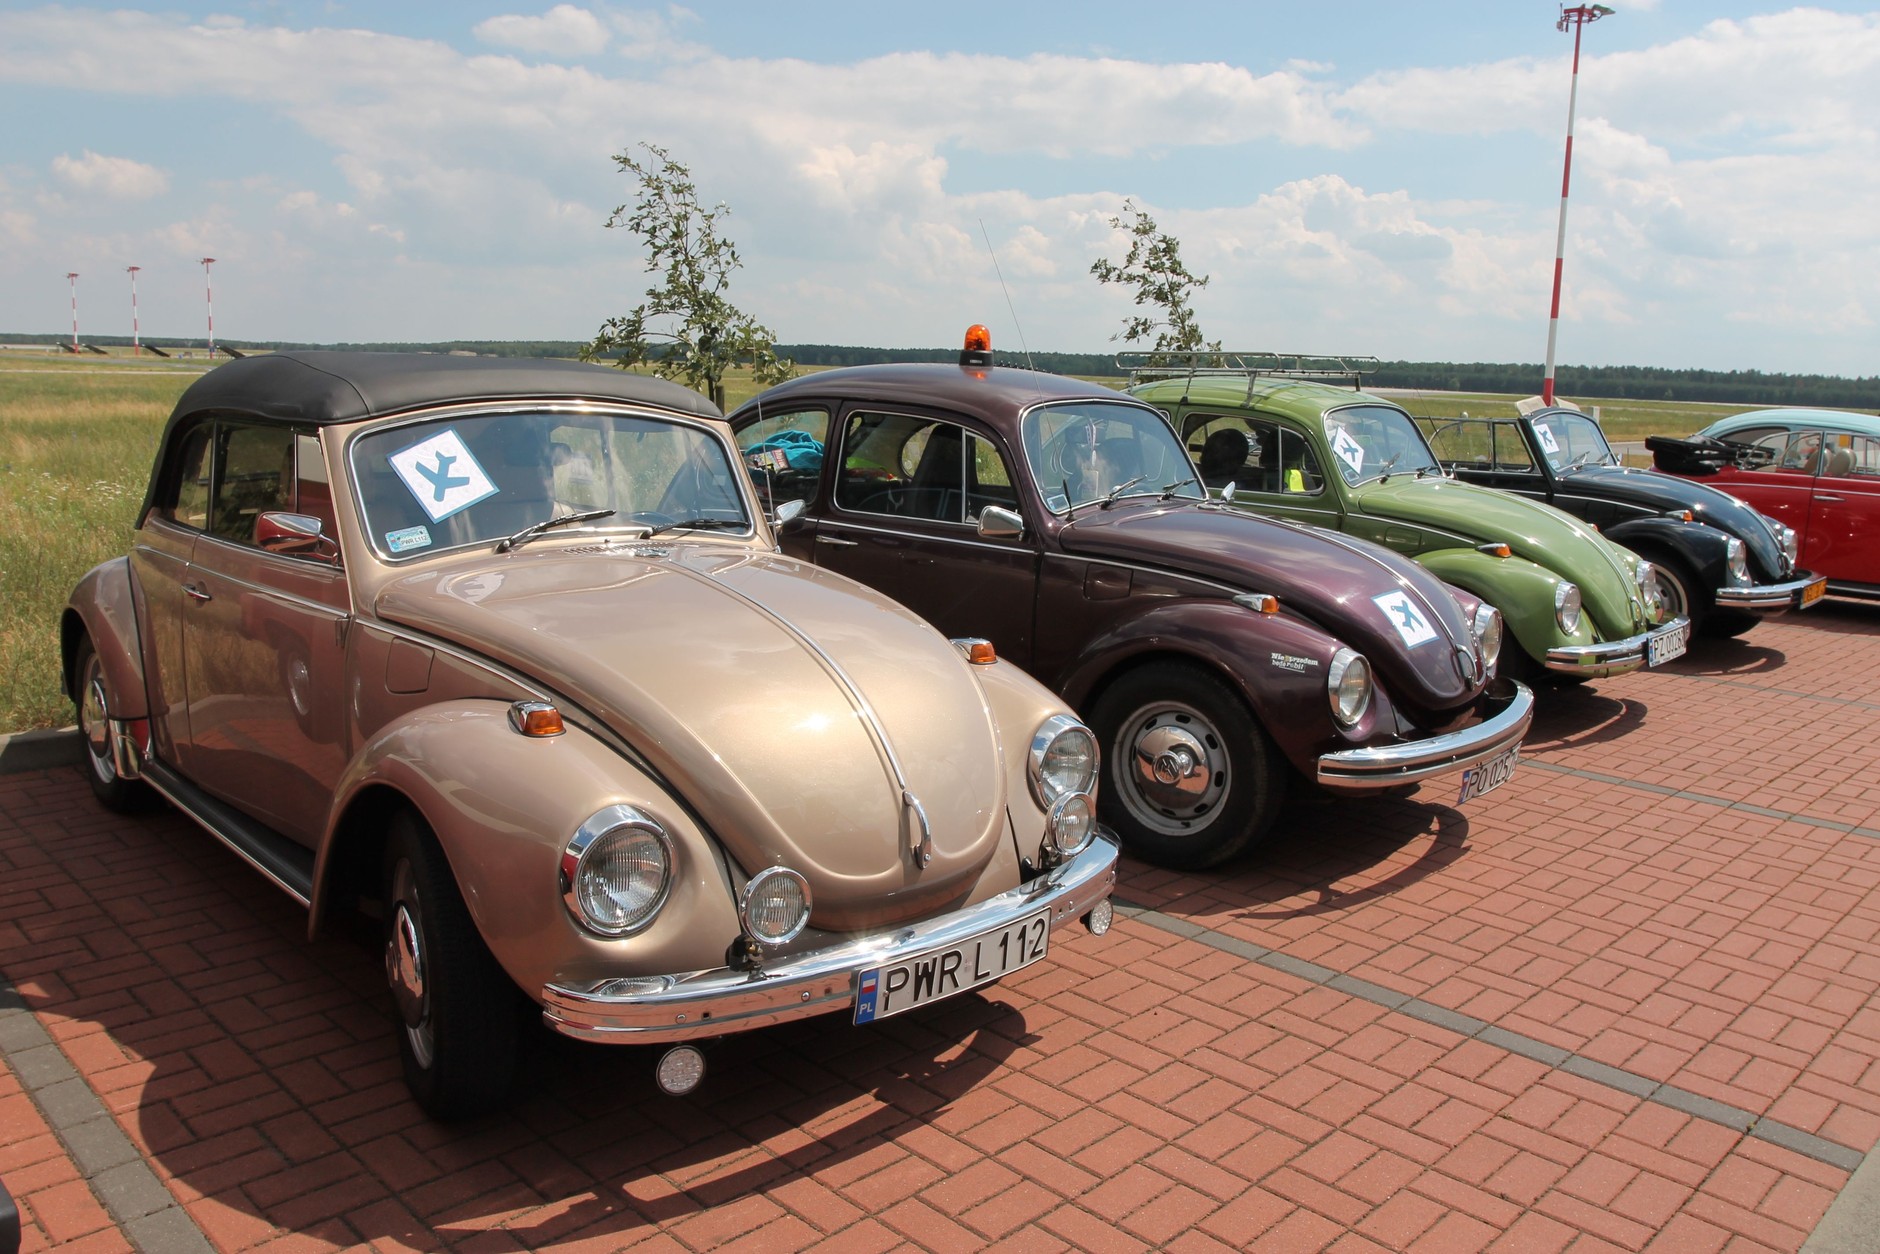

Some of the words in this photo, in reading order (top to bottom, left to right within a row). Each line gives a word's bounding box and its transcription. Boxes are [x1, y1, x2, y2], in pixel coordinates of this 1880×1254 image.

[1653, 637, 1665, 659] PZ
[1466, 768, 1488, 798] PO
[883, 949, 963, 1012] PWR
[973, 917, 1046, 982] L112
[859, 1002, 873, 1015] PL
